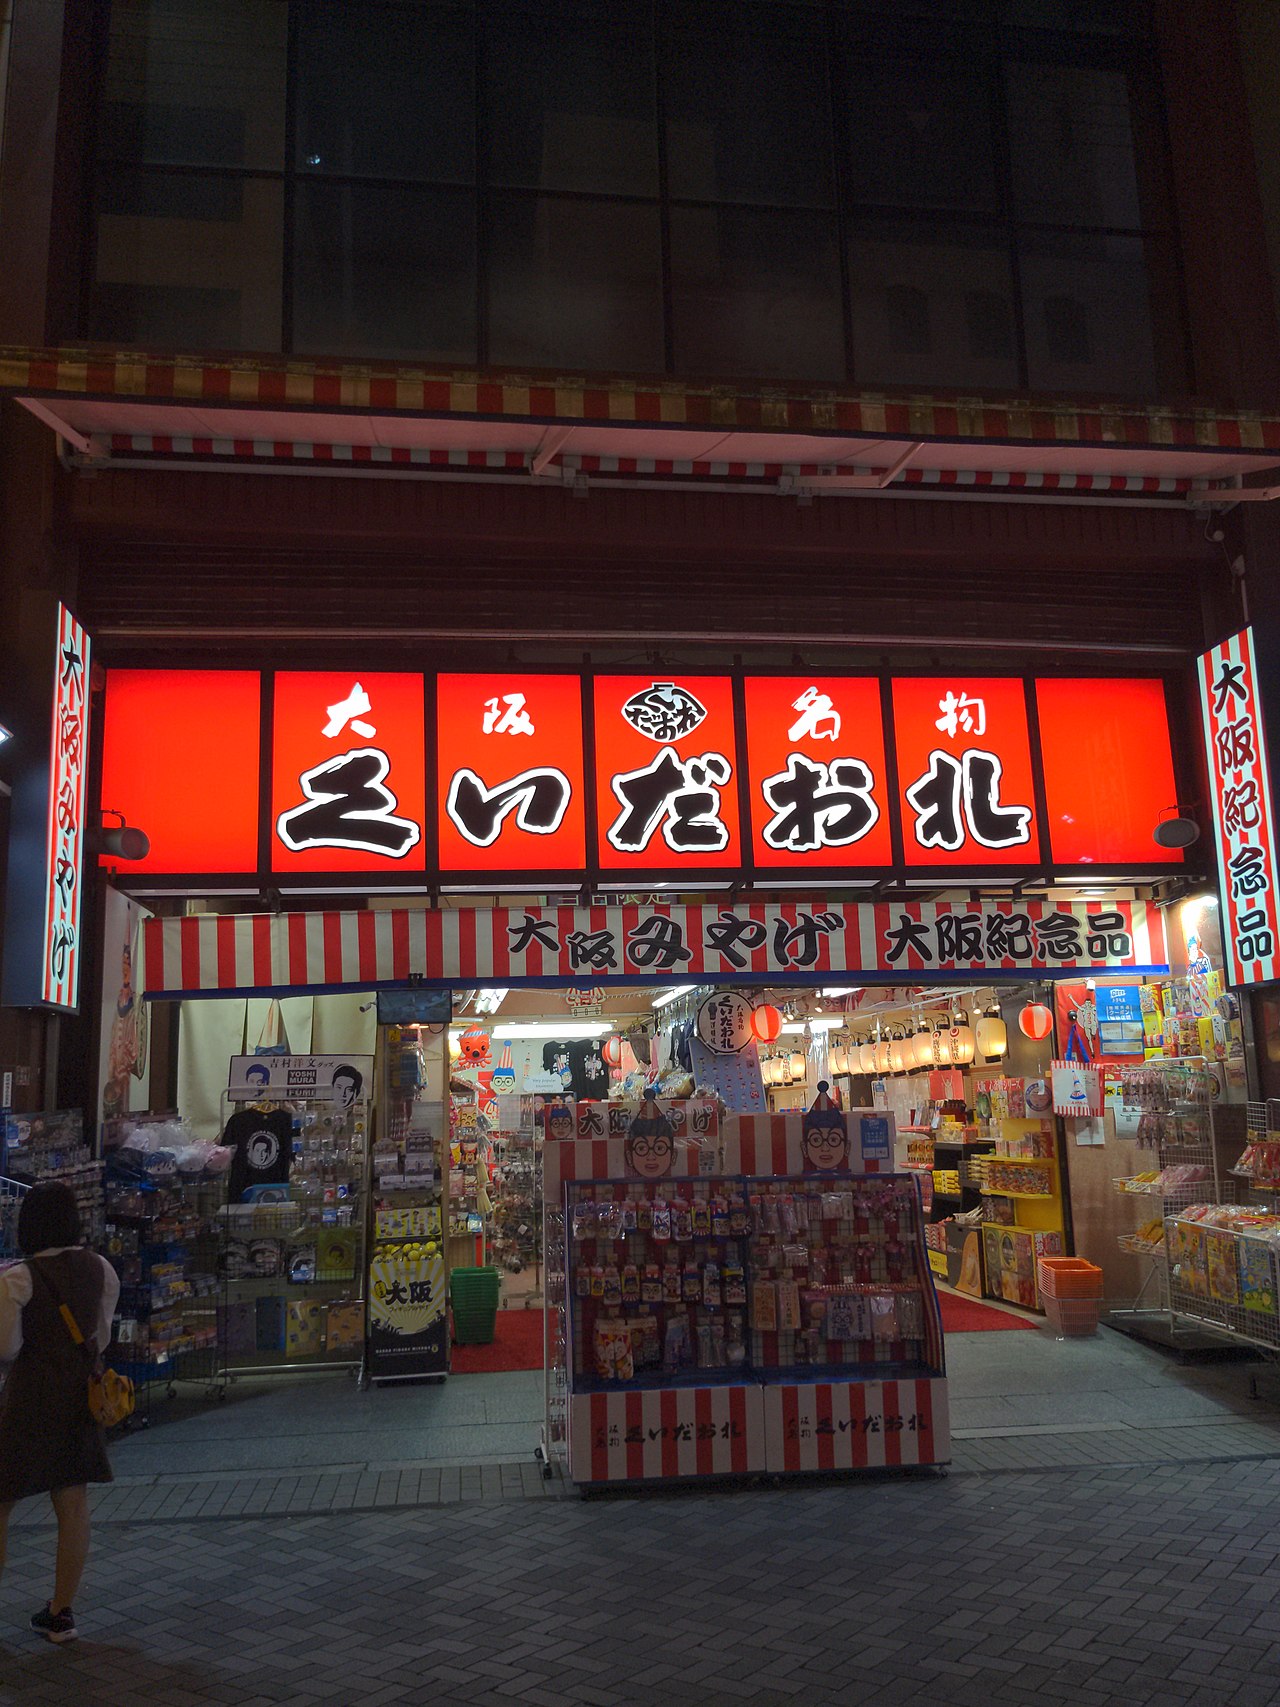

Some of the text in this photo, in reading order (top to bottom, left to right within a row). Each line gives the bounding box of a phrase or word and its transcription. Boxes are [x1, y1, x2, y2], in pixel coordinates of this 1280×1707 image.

[52, 637, 82, 980] 大阪みやげ
[1212, 662, 1273, 963] 大阪紀念品
[507, 911, 846, 969] 大阪みやげ
[885, 911, 1132, 964] 大阪紀念品
[718, 995, 735, 1048] くいだおれ
[288, 1089, 315, 1097] FUMI
[578, 1105, 713, 1135] 大阪やげ
[385, 1280, 433, 1305] 大阪
